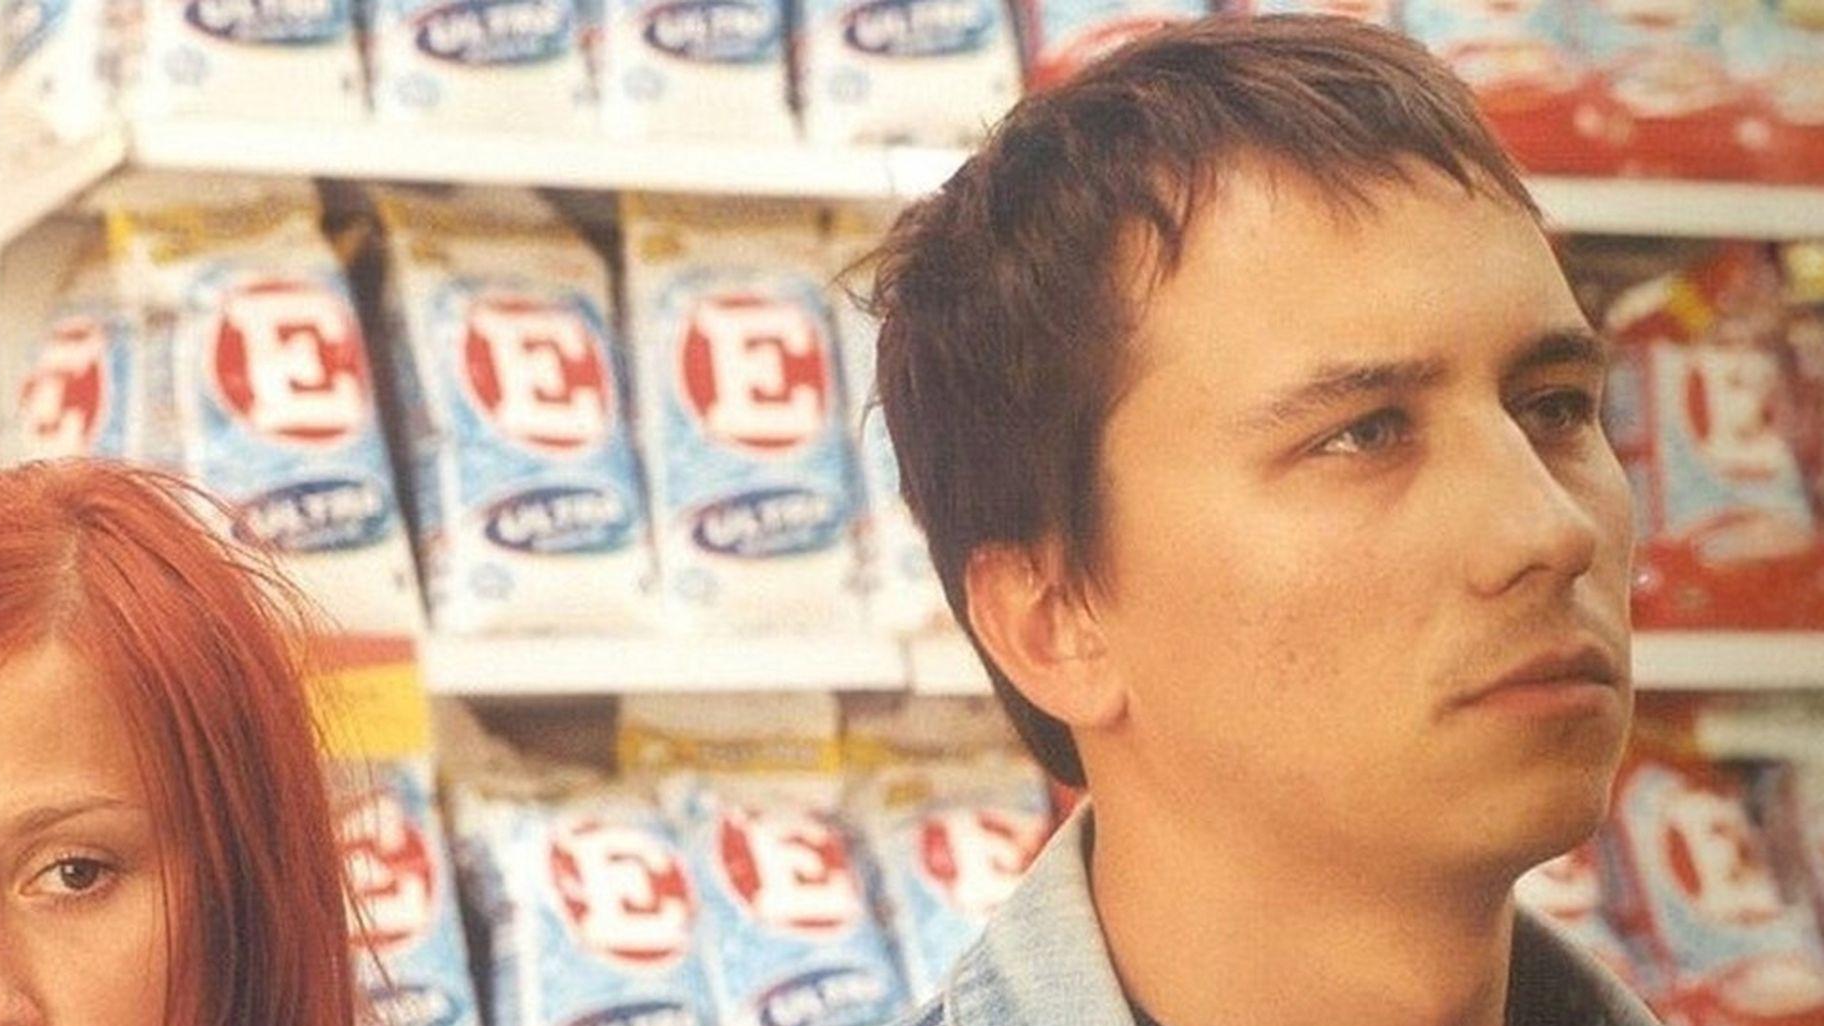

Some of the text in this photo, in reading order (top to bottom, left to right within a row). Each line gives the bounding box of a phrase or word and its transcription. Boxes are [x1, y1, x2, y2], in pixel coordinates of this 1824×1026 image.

[220, 291, 370, 426] E
[470, 308, 606, 438] E
[694, 306, 824, 438] E
[568, 826, 688, 946] E
[738, 806, 858, 918] E
